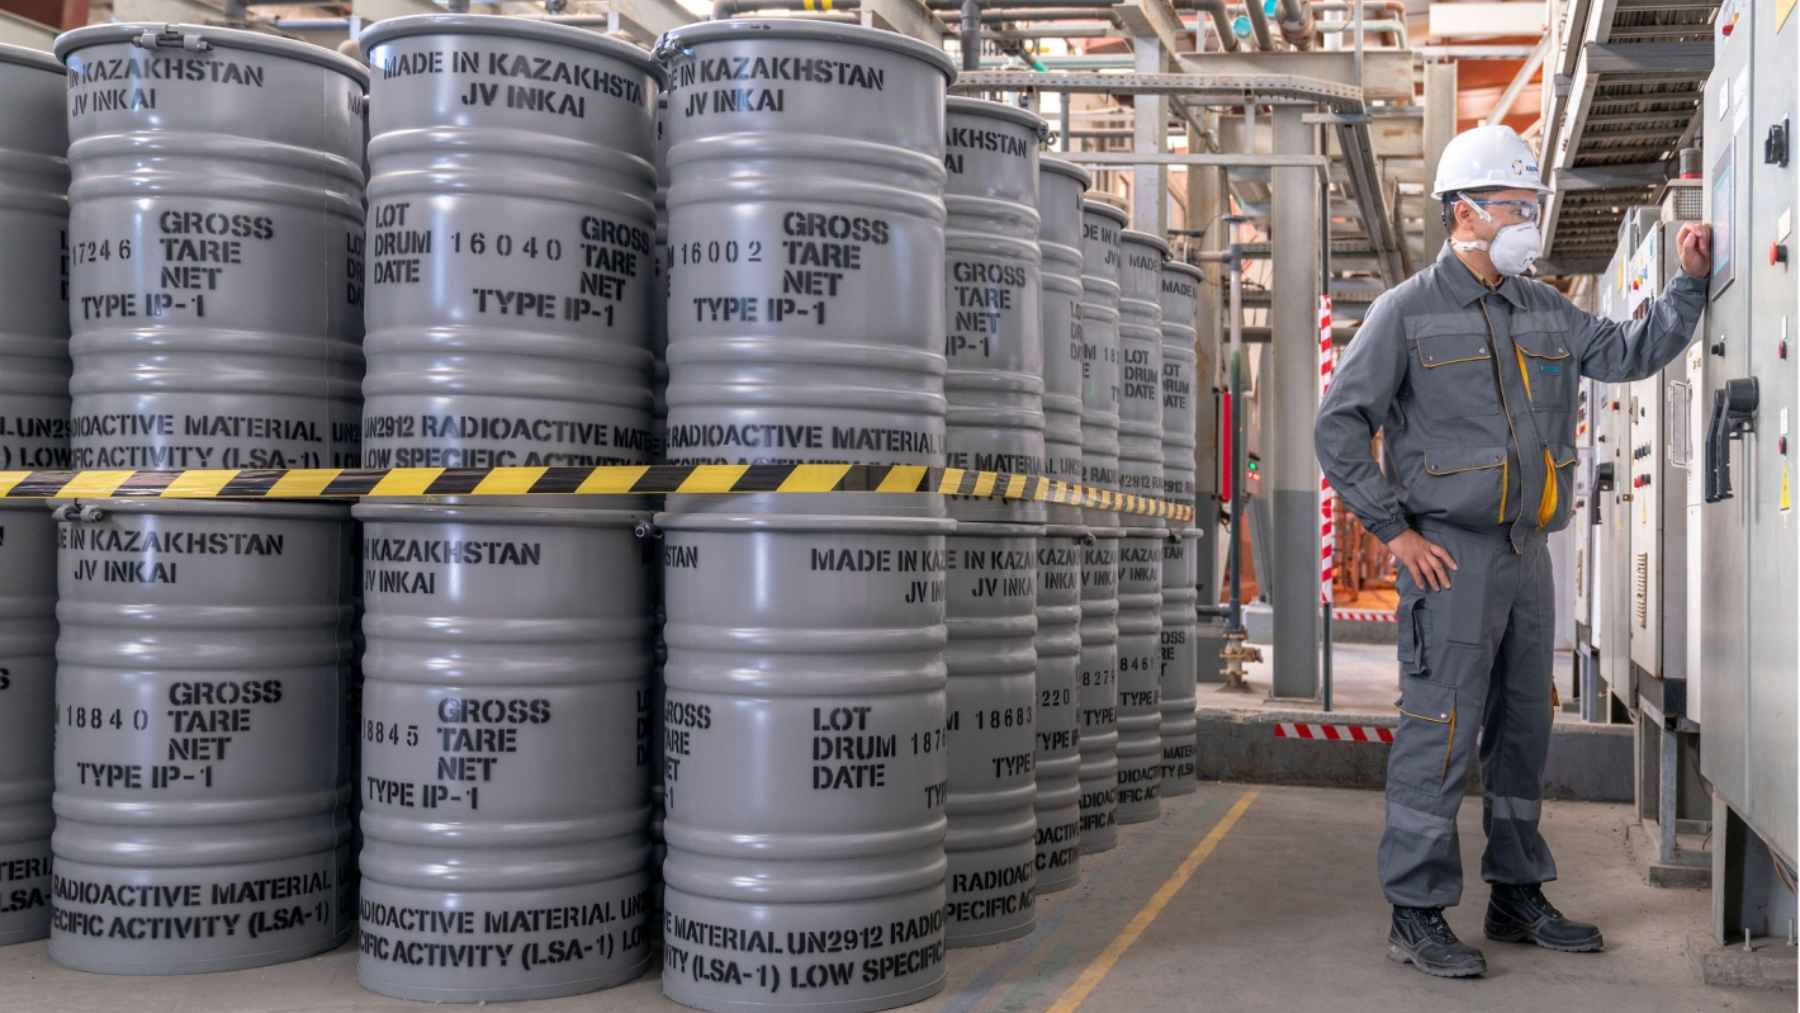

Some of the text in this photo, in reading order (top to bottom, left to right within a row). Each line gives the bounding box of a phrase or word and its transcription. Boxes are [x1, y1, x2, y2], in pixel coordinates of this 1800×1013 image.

[82, 59, 264, 87] KAZAKHSTAN
[383, 52, 443, 79] MADE
[453, 51, 480, 73] IN
[489, 53, 645, 106] KAZAKHSTA
[681, 62, 695, 87] IN
[701, 57, 883, 91] KAZAKHSTAN
[72, 88, 156, 117] JV INKAI
[462, 83, 585, 118] JV INKAI
[686, 89, 784, 117] JV INKAI
[159, 211, 274, 240] GROSS
[375, 203, 410, 228] LOT
[783, 212, 889, 244] GROSS
[374, 230, 562, 260] DRUM 16040
[581, 215, 651, 255] GROSS
[72, 239, 131, 266] 17246
[160, 238, 241, 264] TARE
[581, 244, 637, 277] TARE
[682, 241, 762, 264] 16002
[783, 241, 861, 269] TARE
[161, 267, 222, 290] NET
[374, 259, 420, 284] DATE
[783, 270, 843, 296] NET
[953, 262, 1026, 287] GROSS
[580, 272, 626, 300] NET
[954, 286, 1011, 310] TARE
[82, 293, 205, 319] TYPE IP-1
[473, 288, 614, 327] TYPE IP-1
[693, 298, 825, 325] TYPE IP-1
[956, 312, 1000, 334] NET
[1124, 348, 1149, 365] LOT
[1124, 366, 1158, 384] DRUM
[1163, 363, 1180, 377] OT
[1124, 383, 1155, 400] DATE
[185, 415, 322, 442] MATERIAL
[365, 415, 414, 439] UN2912
[422, 415, 608, 446] RADIOACTIVE
[672, 424, 823, 449] RADIOACTIVE
[99, 446, 213, 469] ACTIVITY
[365, 449, 391, 469] LOW
[395, 449, 516, 469] SPECIFIC
[70, 529, 85, 550] IN
[91, 530, 283, 555] KAZAKHSTAN
[371, 539, 540, 565] KAZAKHSTAN
[75, 559, 177, 583] JV INKAI
[811, 549, 890, 571] MADE
[898, 549, 917, 571] IN
[964, 550, 984, 569] IN
[379, 571, 435, 594] INKAI
[906, 582, 928, 603] JV
[972, 579, 997, 597] JV
[1045, 572, 1074, 589] INKA
[169, 679, 283, 706] GROSS
[1120, 690, 1152, 706] TYPE
[67, 704, 148, 730] 18840
[168, 708, 251, 733] TARE
[438, 698, 551, 724] GROSS
[813, 707, 871, 731] LOT
[1083, 707, 1114, 726] TYPE
[168, 737, 231, 760] NET
[437, 728, 517, 752] TARE
[812, 734, 896, 761] DRUM
[77, 763, 213, 789] TYPE IP-1
[438, 757, 498, 781] NET
[812, 764, 885, 790] DATE
[993, 753, 1031, 778] TYPE
[367, 776, 478, 810] TYPE IP-1
[54, 875, 201, 908] RADIOACTIVE
[212, 871, 331, 905] MATERIAL
[953, 861, 1033, 893] RADIOACT
[109, 914, 241, 939] ACTIVITY
[248, 901, 330, 938] (LSA-1)
[484, 902, 615, 933] MATERIAL
[946, 894, 1016, 922] PECIFIC
[675, 914, 783, 954] MATERIAL
[788, 926, 883, 955] UN2912
[890, 911, 944, 942] RADIO
[392, 941, 513, 967] ACTIVITY
[522, 935, 614, 971] (LSA-1)
[692, 954, 780, 992] (LSA-1)
[791, 962, 854, 988] LOW
[862, 941, 943, 983] SPECIFIC
